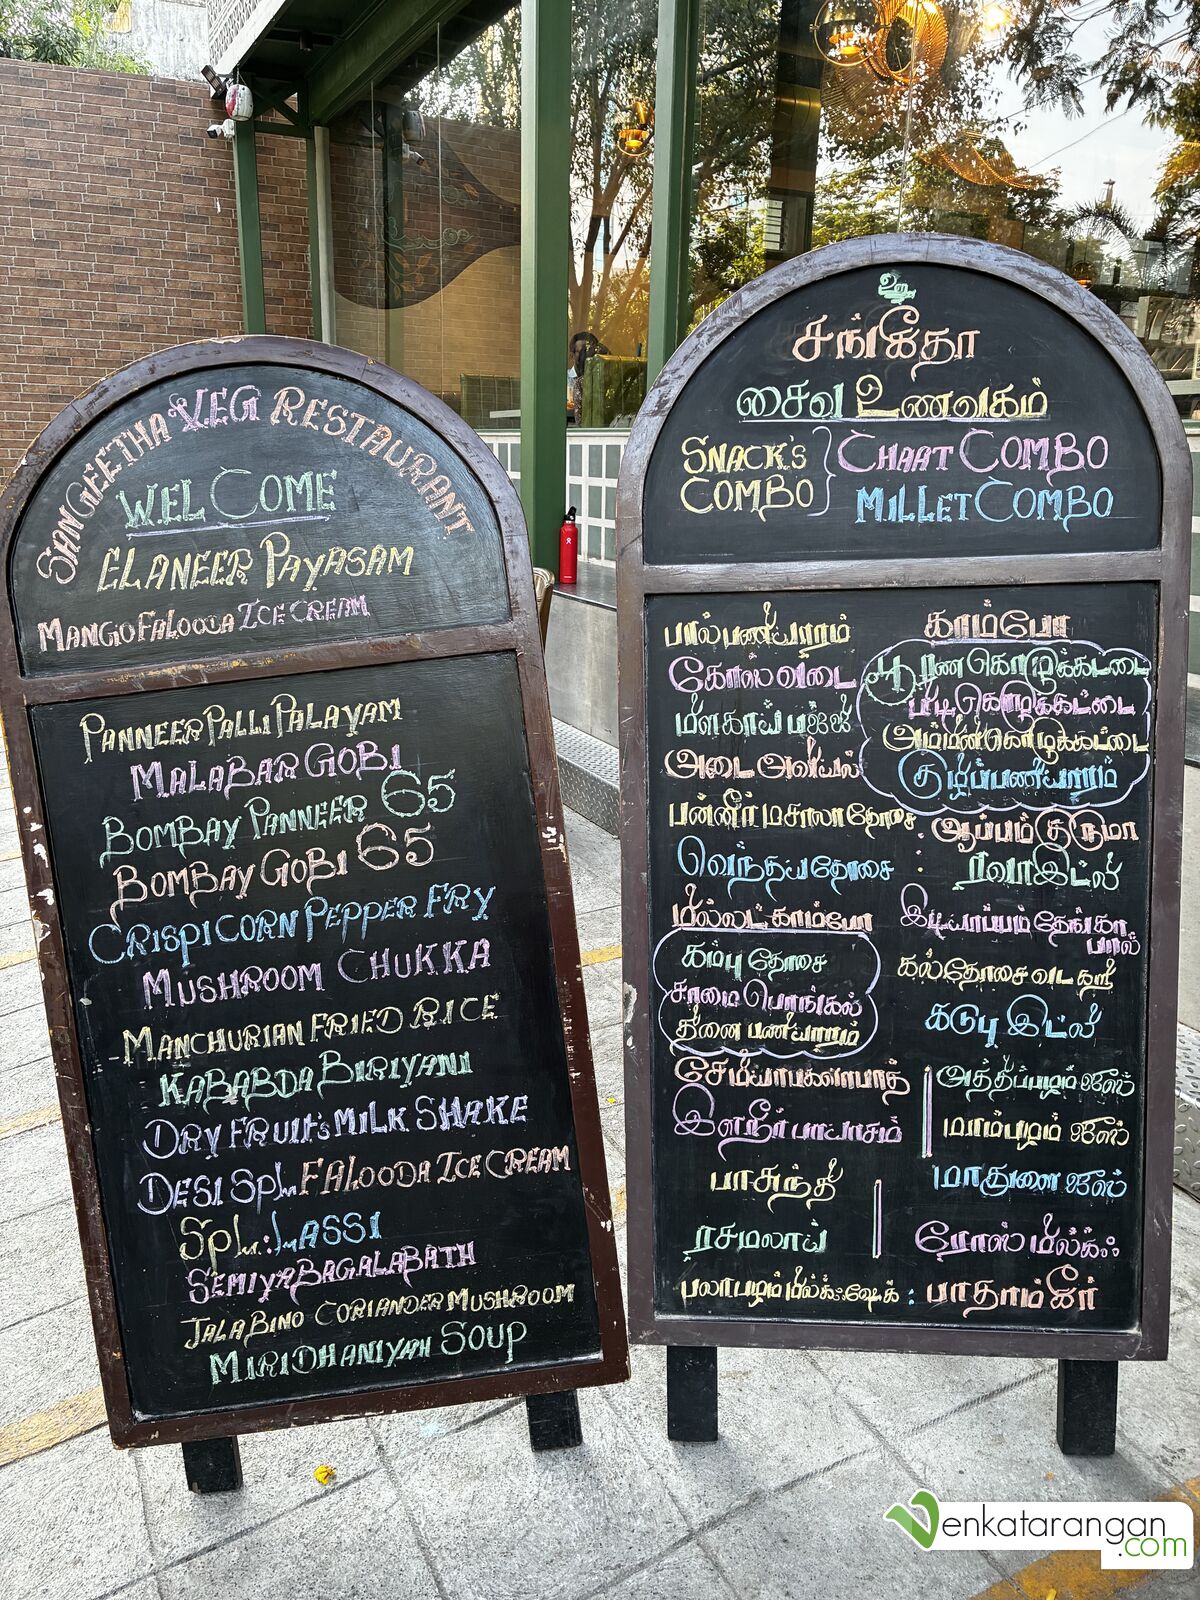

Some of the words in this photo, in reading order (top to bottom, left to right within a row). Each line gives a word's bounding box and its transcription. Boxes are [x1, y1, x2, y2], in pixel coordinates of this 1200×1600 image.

[793, 304, 981, 381] சங்கீதா
[736, 381, 844, 419] சைவ
[36, 413, 172, 585] SANGEETHA
[168, 384, 262, 432] VEG
[269, 386, 475, 540] RESTAURANT
[837, 429, 955, 473] CHAAT
[959, 428, 1109, 487] COMBO
[680, 475, 814, 522] COMBO
[974, 476, 1114, 532] COMBO
[97, 545, 254, 593] ELANEER
[260, 531, 415, 592] PAYASAM
[237, 598, 286, 631] ICE
[924, 599, 1072, 639] காம்போ
[79, 712, 202, 764] PANNEER
[664, 748, 755, 780] அடை
[130, 752, 300, 802] MALABAR
[304, 740, 402, 781] GOBI
[100, 814, 243, 867] BOMBAY
[245, 796, 369, 841] PANNEER
[381, 768, 457, 817] 65
[931, 811, 1034, 853] ஆப்பம்
[110, 861, 256, 926] BOMBAY
[260, 847, 348, 895] GOBI
[356, 822, 435, 871] 65
[88, 923, 212, 968] CRISPI
[215, 911, 299, 945] CORN
[304, 895, 417, 944] PEPPER
[423, 882, 496, 921] FRY
[143, 961, 325, 1010] MUSHROOM
[338, 937, 492, 984] CHUKKA
[681, 940, 743, 982] கம்பு
[748, 947, 828, 982] தோசை
[743, 978, 863, 1017] பொங்கல்
[1006, 993, 1103, 1040] இட்லி
[121, 1020, 305, 1066] MANCHURIAN
[310, 1005, 404, 1043] FRIED
[413, 993, 501, 1029] RICE
[317, 1049, 474, 1100] BIRIYANI
[142, 1118, 222, 1160] DRY
[415, 1094, 529, 1134] SHAKE
[137, 1171, 224, 1216] DESI
[298, 1155, 432, 1198] FALOODA
[434, 1149, 482, 1185] ICE
[485, 1144, 573, 1179] CREAM
[314, 1291, 444, 1326] CORIANDER
[446, 1283, 577, 1313] MUSHROOM
[440, 1320, 529, 1364] SOUP
